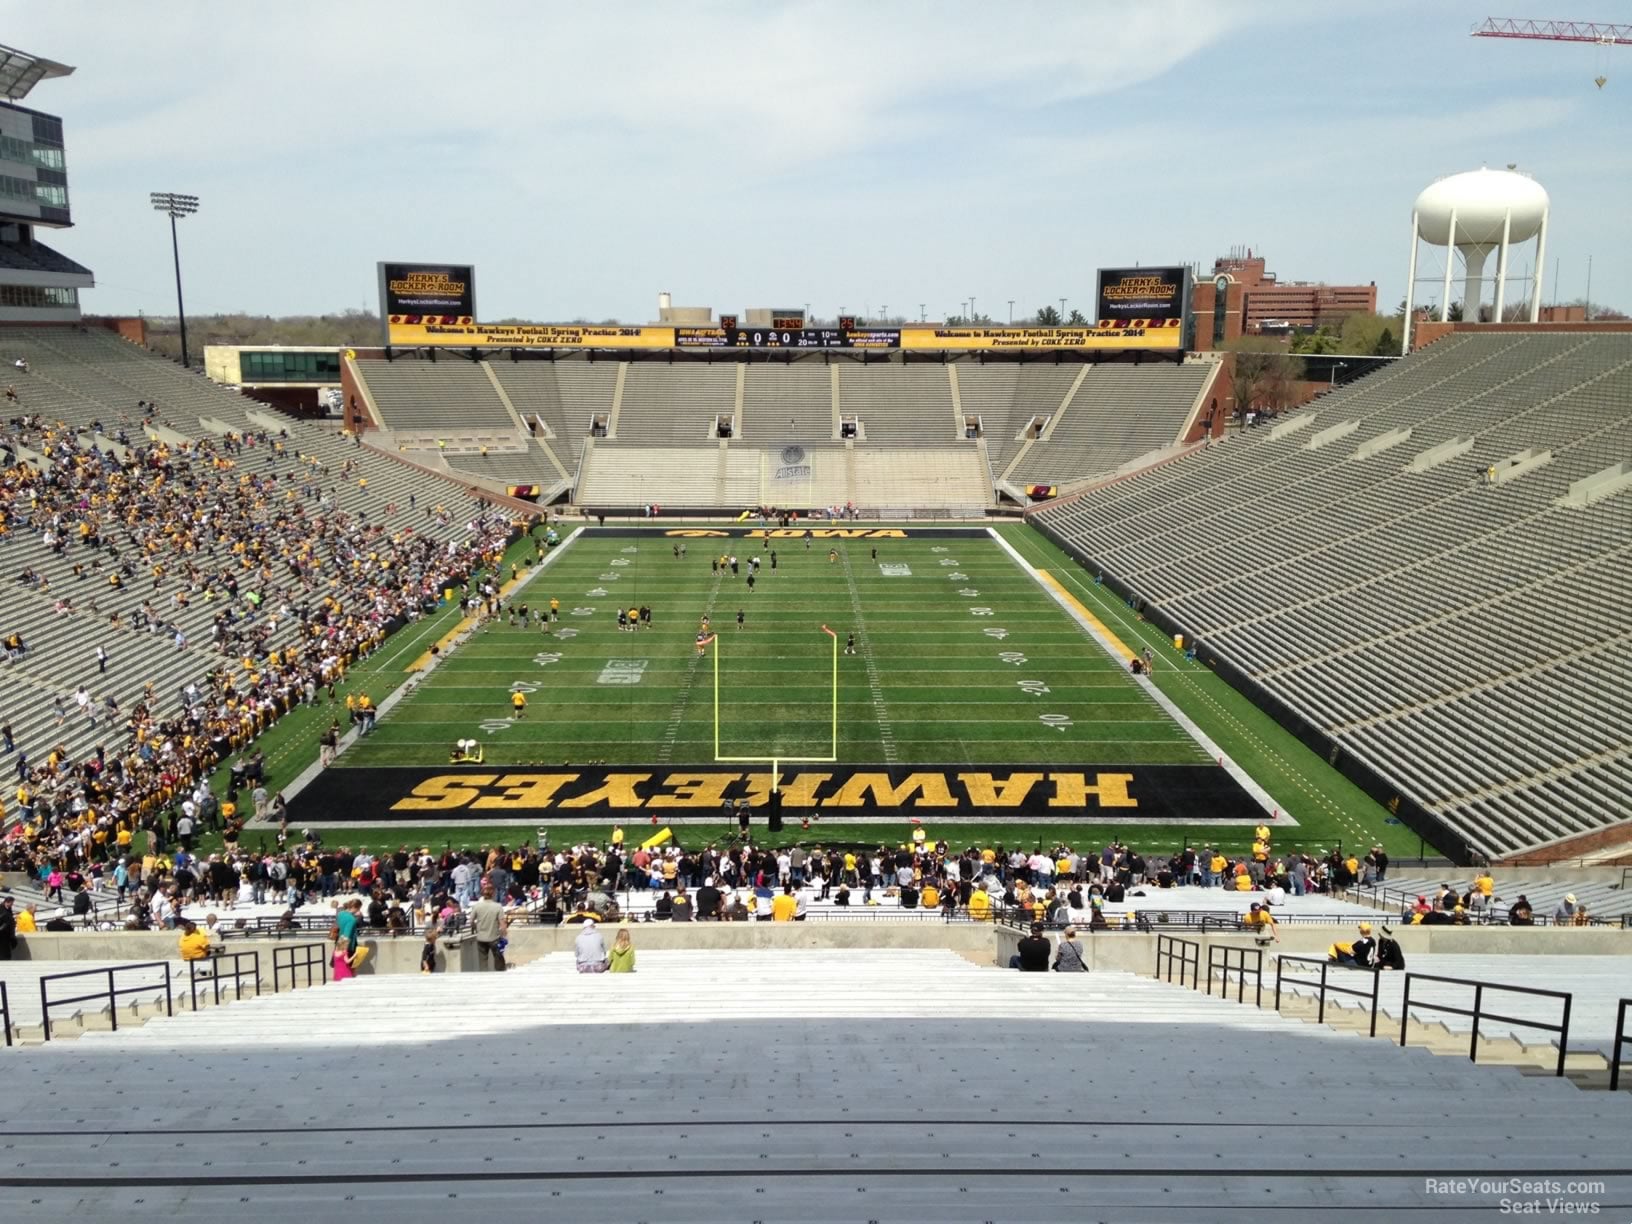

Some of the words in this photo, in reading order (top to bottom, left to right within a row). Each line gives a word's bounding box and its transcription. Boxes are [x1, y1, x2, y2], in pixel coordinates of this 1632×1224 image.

[391, 281, 427, 291] LOCKER
[437, 282, 464, 292] ROOM
[1104, 286, 1138, 295] LOCKER
[1148, 285, 1176, 295] ROOM
[425, 325, 464, 334] Welcome
[477, 327, 515, 336] Hawkeye
[517, 327, 549, 335] Football
[551, 328, 580, 337] Spring
[582, 328, 617, 336] Practice
[934, 330, 971, 338] Welcome
[973, 330, 981, 338] to
[983, 330, 1021, 339] Hawkeye
[1023, 329, 1054, 337] Football
[1056, 329, 1084, 339] Spring
[1086, 329, 1121, 337] Practice
[486, 335, 524, 343] Presented
[526, 336, 535, 345] by
[754, 332, 762, 343] 0
[782, 332, 791, 343] 0
[992, 338, 1030, 346] Presented
[1031, 338, 1040, 347] by
[775, 466, 811, 480] Allstate
[743, 529, 909, 538] IOWA
[387, 772, 1139, 811] HAWKEYES
